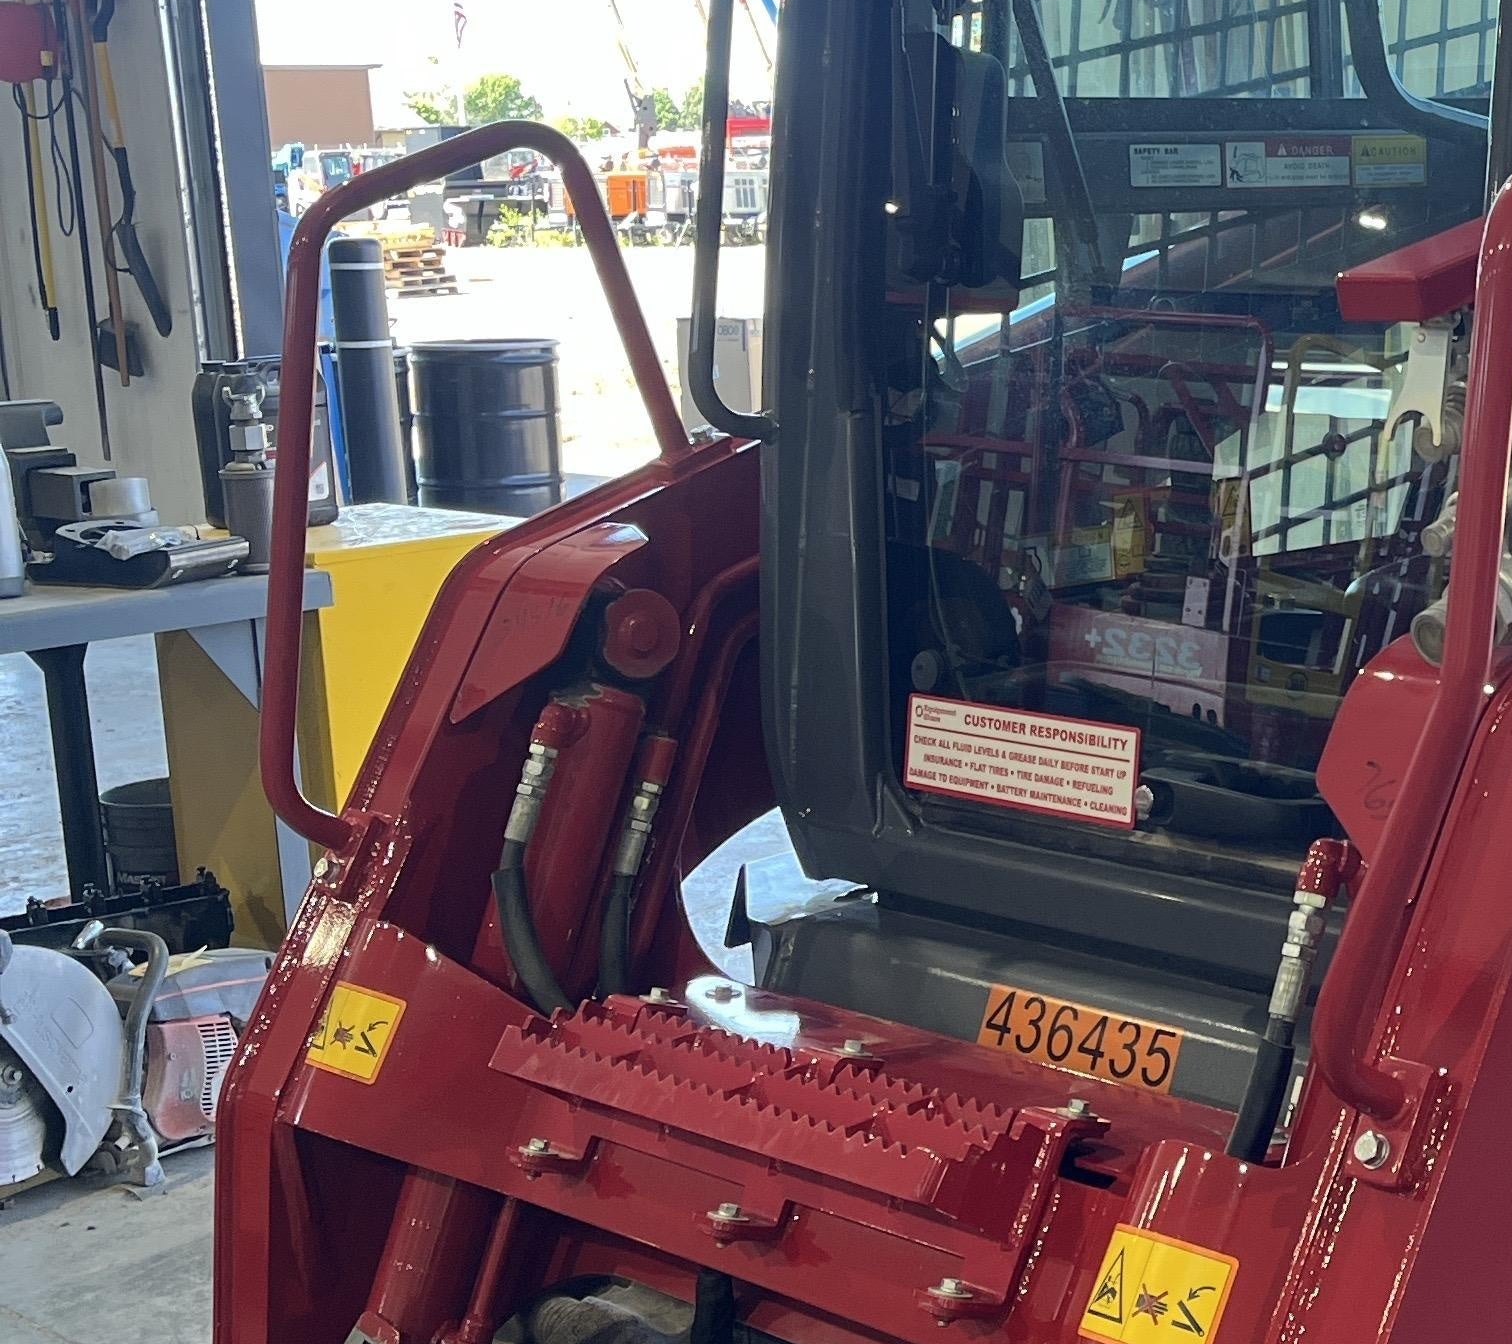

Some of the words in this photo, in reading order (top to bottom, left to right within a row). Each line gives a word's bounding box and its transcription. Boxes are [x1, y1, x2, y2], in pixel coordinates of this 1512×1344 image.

[1290, 145, 1334, 156] DANGER
[1370, 145, 1417, 157] CAUTION
[964, 714, 1027, 735] CUSTOMER
[1029, 724, 1128, 751] RESPONSIBILITY
[913, 734, 937, 746] CHECK
[938, 738, 951, 749] ALL
[952, 741, 973, 753] FLUID
[973, 745, 1000, 758] LEVELS
[1001, 750, 1007, 759] &
[1008, 751, 1037, 765] GREASE
[1038, 756, 1059, 769] DAILY
[1060, 760, 1089, 774] BEFORE
[1091, 765, 1115, 779] START
[1116, 770, 1127, 780] UP
[923, 753, 963, 768] INSURANCE
[969, 761, 987, 773] FLAT
[988, 764, 1009, 776] TIRES
[1016, 770, 1033, 782] TIRE
[1034, 773, 1065, 787] DAMAGE
[1072, 779, 1113, 796] REFUELING
[909, 767, 937, 781] DAMAGE
[938, 772, 948, 783] TO
[949, 774, 989, 790] EQUIPMENT
[996, 783, 1028, 797] BATTERY
[1029, 790, 1082, 808] MAINTENANCE
[1089, 800, 1128, 816] CLEANING
[985, 991, 1177, 1087] 436435
